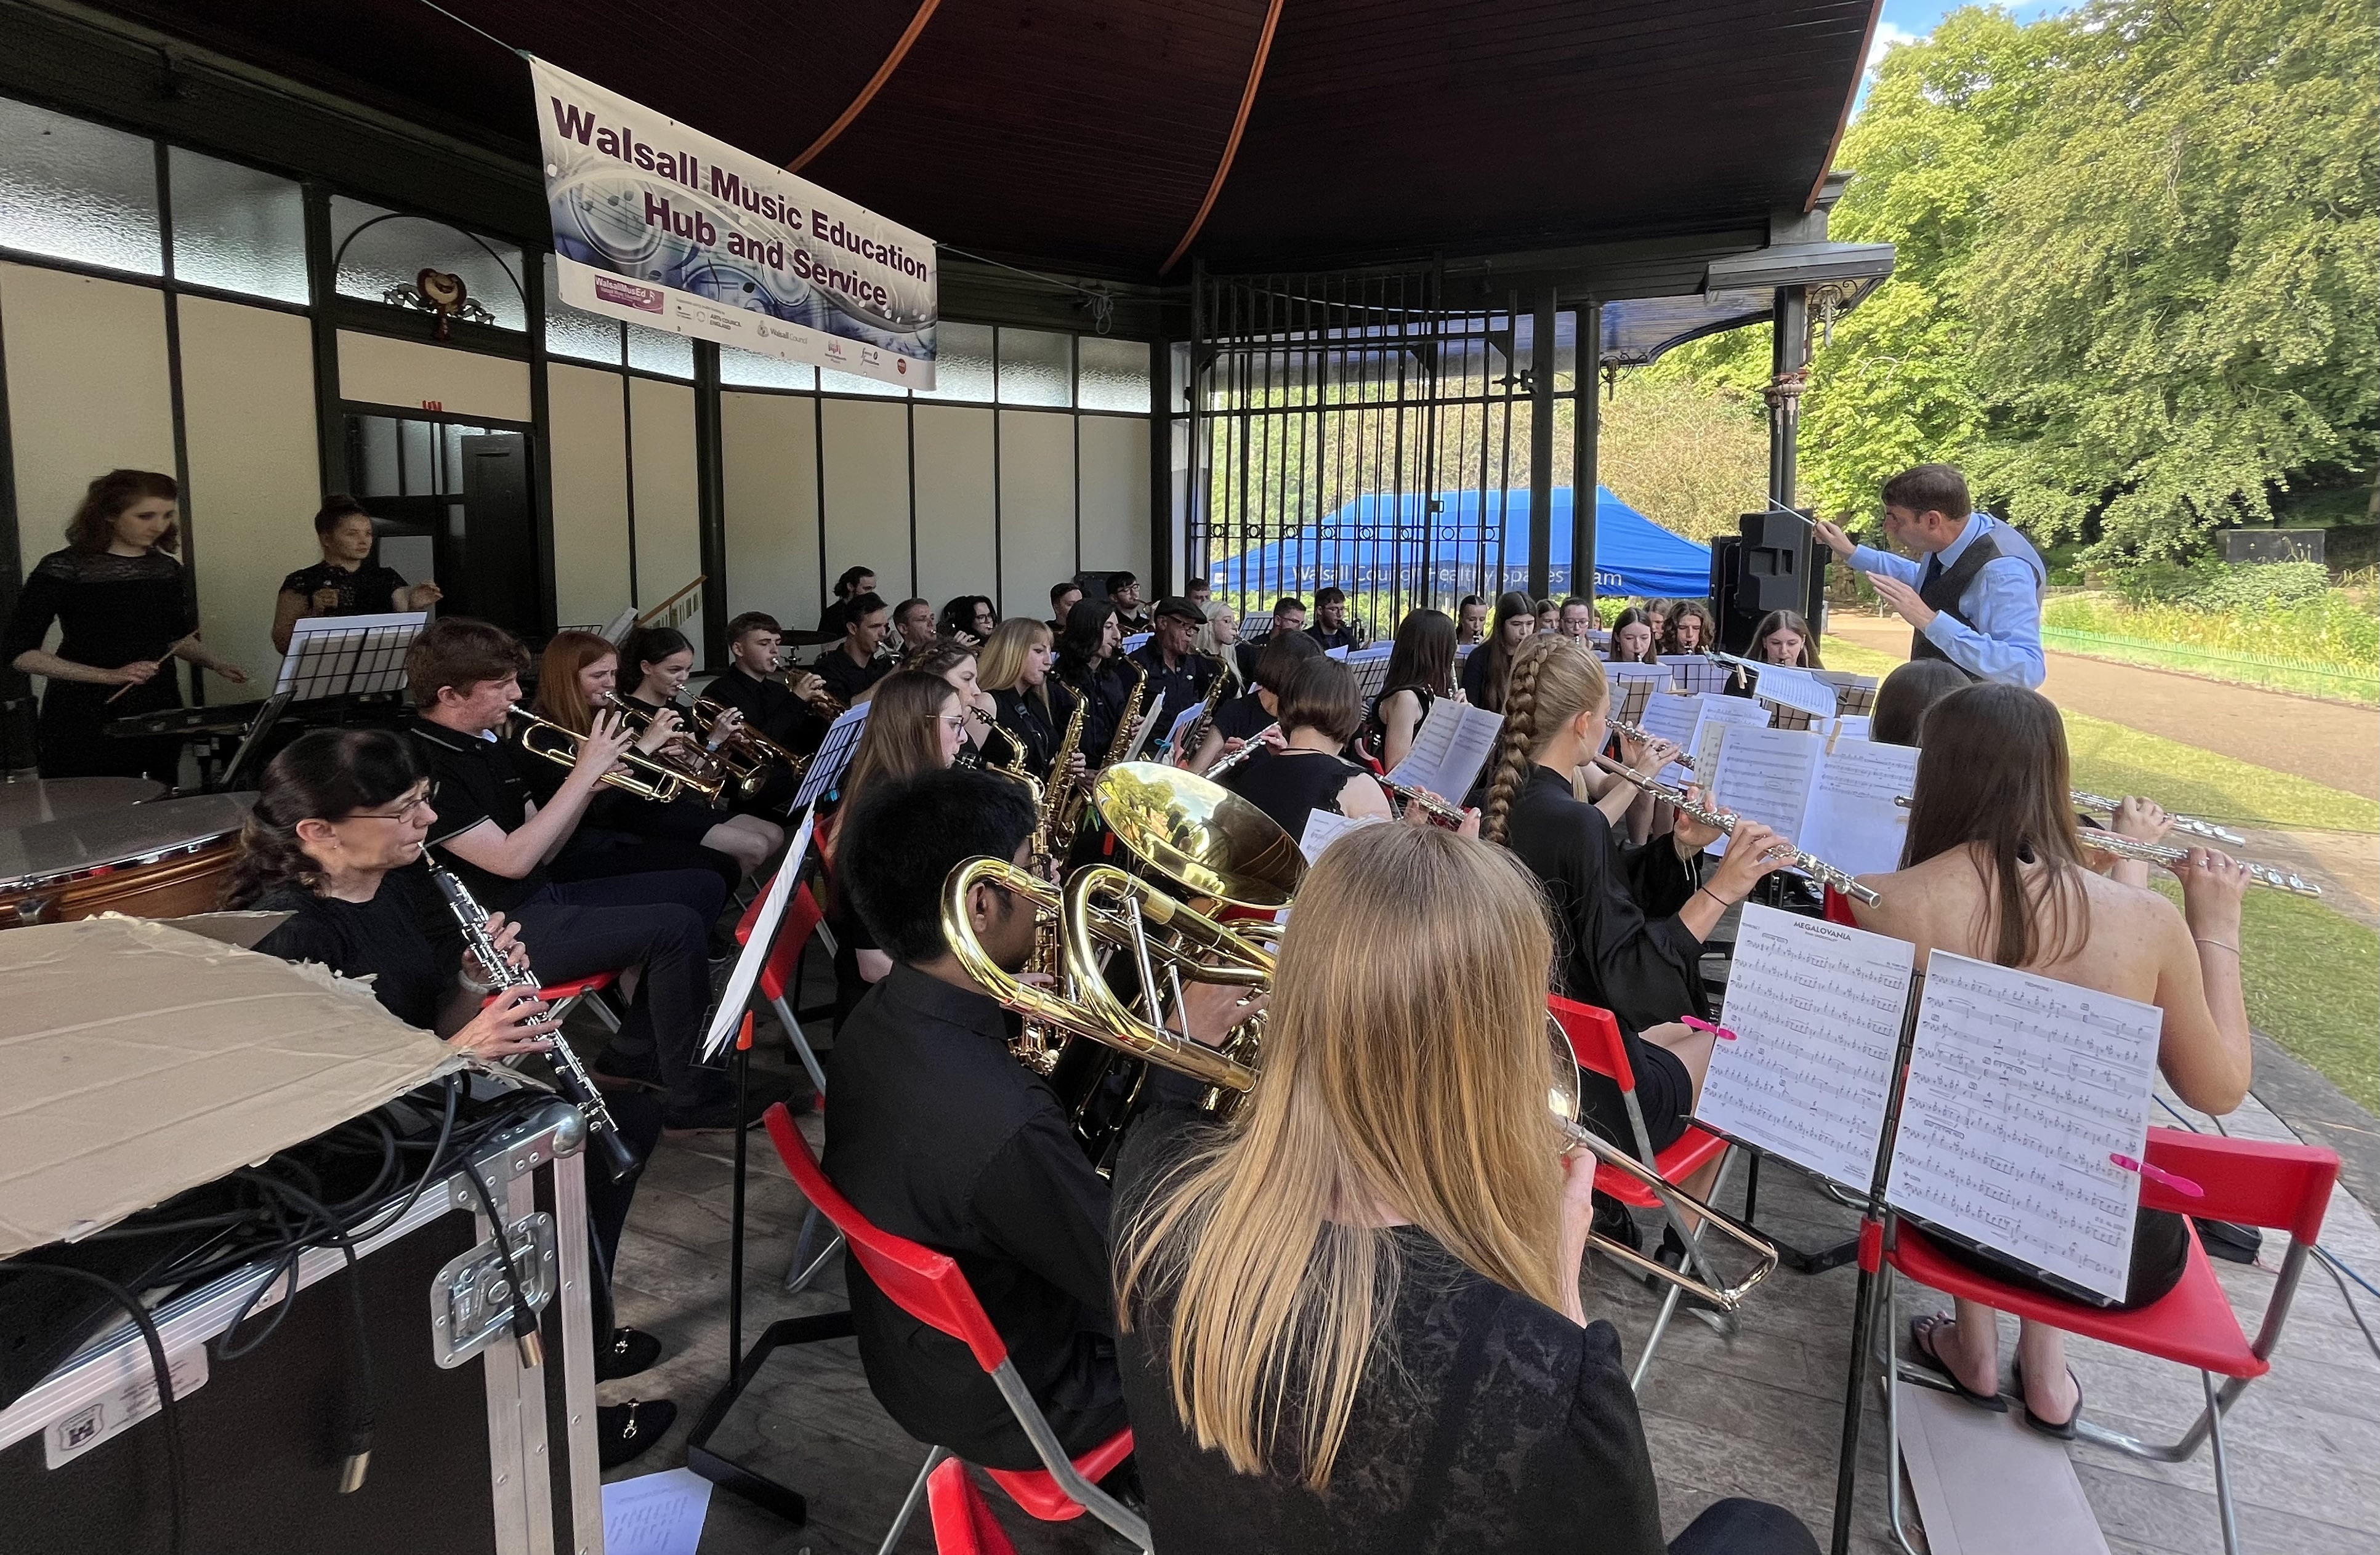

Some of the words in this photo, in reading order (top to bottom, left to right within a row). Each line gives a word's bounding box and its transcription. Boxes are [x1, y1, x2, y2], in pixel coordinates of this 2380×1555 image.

[551, 96, 698, 190] Walsall
[711, 165, 802, 230] Music
[812, 209, 927, 282] Education
[644, 191, 716, 246] Hub
[728, 231, 783, 271] and
[793, 249, 887, 306] Service
[595, 277, 647, 298] WalsallMusEd
[1292, 565, 1349, 581] Walsall
[1793, 921, 1852, 941] MEGALOVANIA
